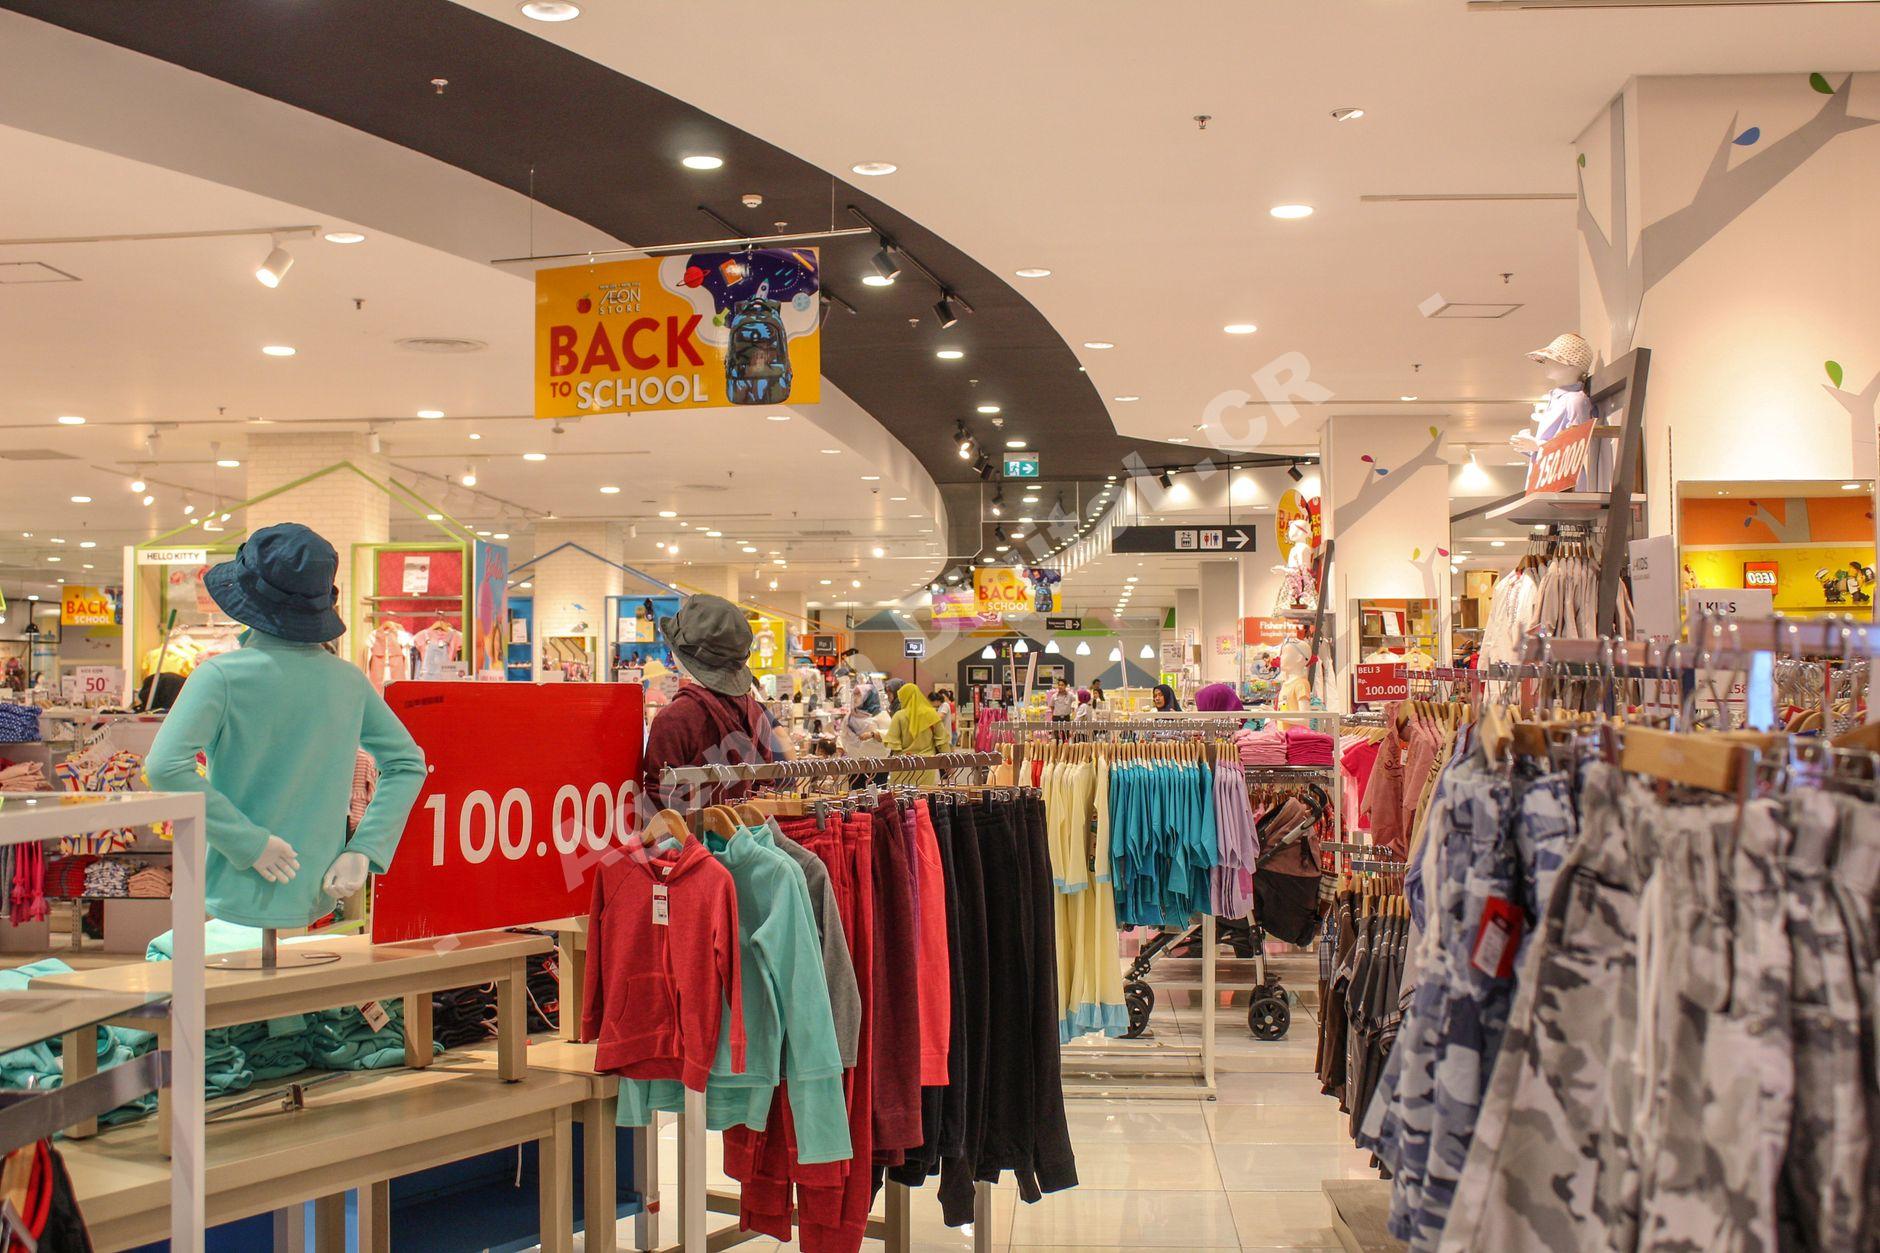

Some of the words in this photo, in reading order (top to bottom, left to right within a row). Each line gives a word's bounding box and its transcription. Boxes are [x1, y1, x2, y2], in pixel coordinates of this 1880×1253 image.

[599, 304, 641, 315] STORE
[550, 314, 705, 377] BACK
[550, 381, 572, 398] TO
[577, 374, 709, 409] SCHOOL
[1535, 438, 1586, 489] 150.000
[175, 552, 199, 560] KITTY
[979, 585, 1028, 601] BACK
[66, 600, 109, 615] BACK
[988, 601, 1030, 611] SCHOOL
[74, 615, 110, 625] SCHOOL
[1365, 685, 1406, 695] 100.000
[424, 779, 643, 867] 100.000
